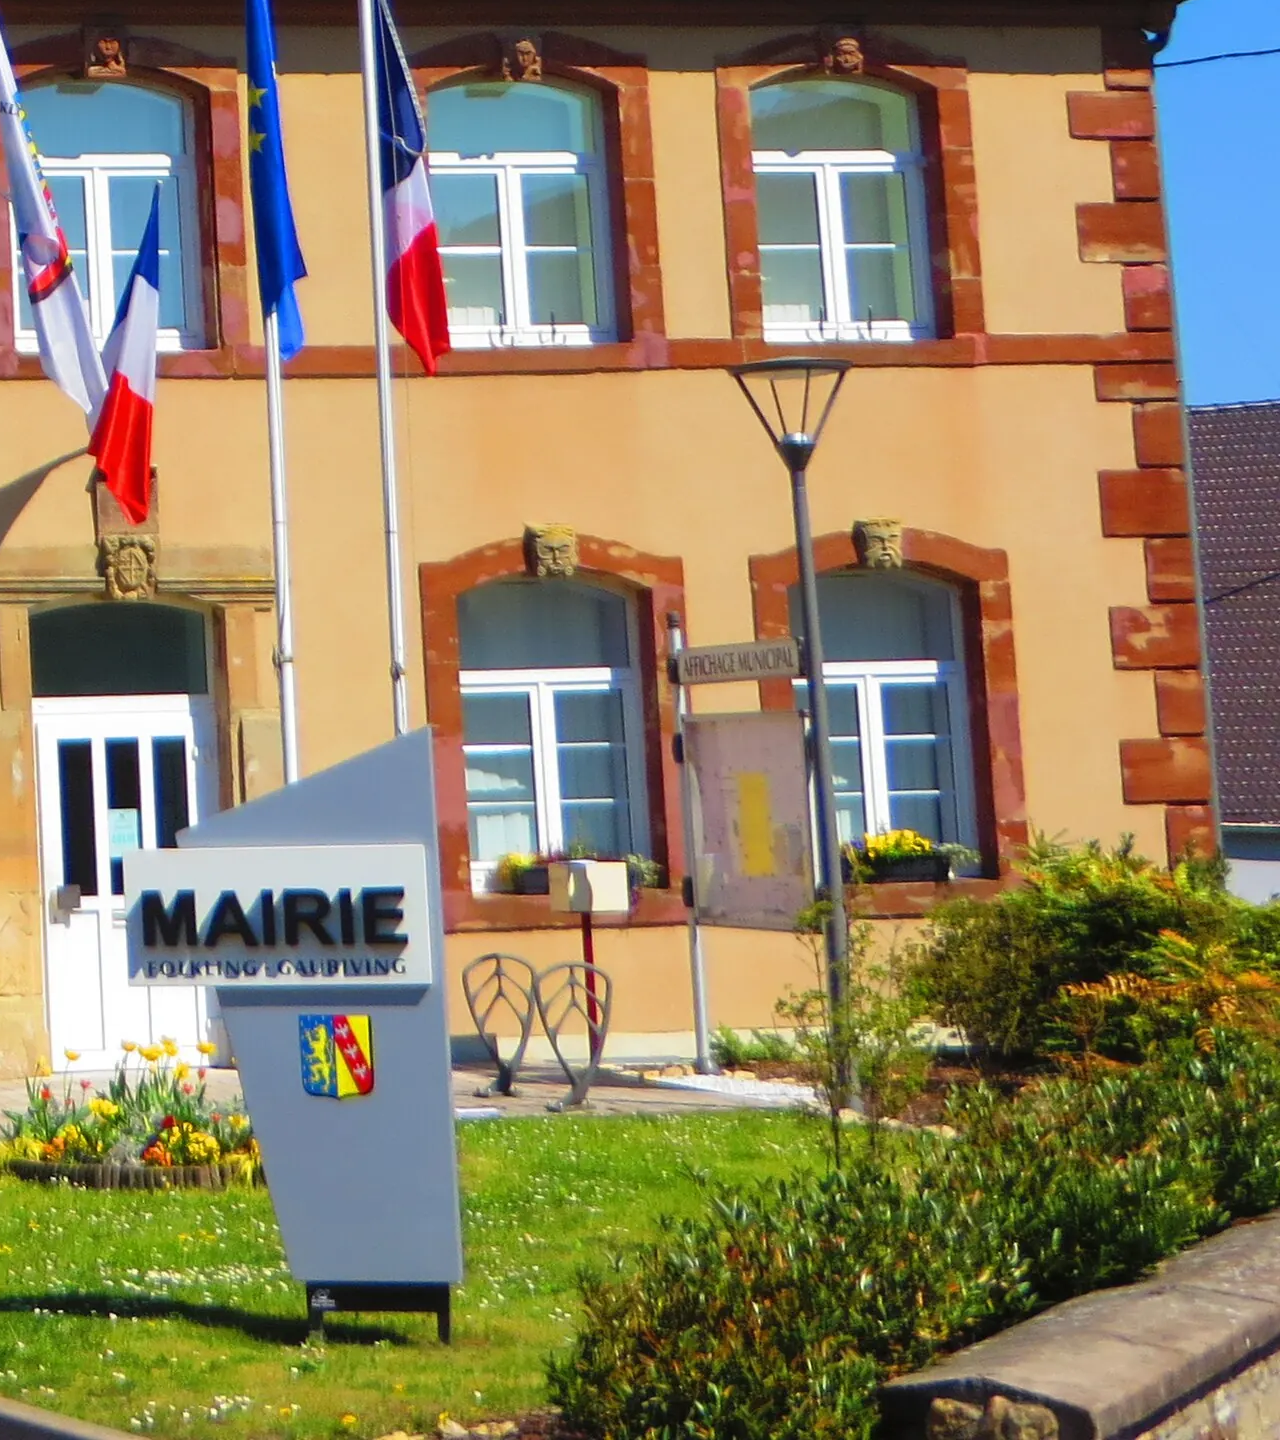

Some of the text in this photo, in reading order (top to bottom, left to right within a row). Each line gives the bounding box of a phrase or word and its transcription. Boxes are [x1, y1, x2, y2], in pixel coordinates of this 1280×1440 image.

[684, 645, 794, 677] AFFICHAGE MUNICIPAL
[140, 885, 410, 948] MAIRIE
[146, 957, 408, 978] FOLKLING GAUBIVING
